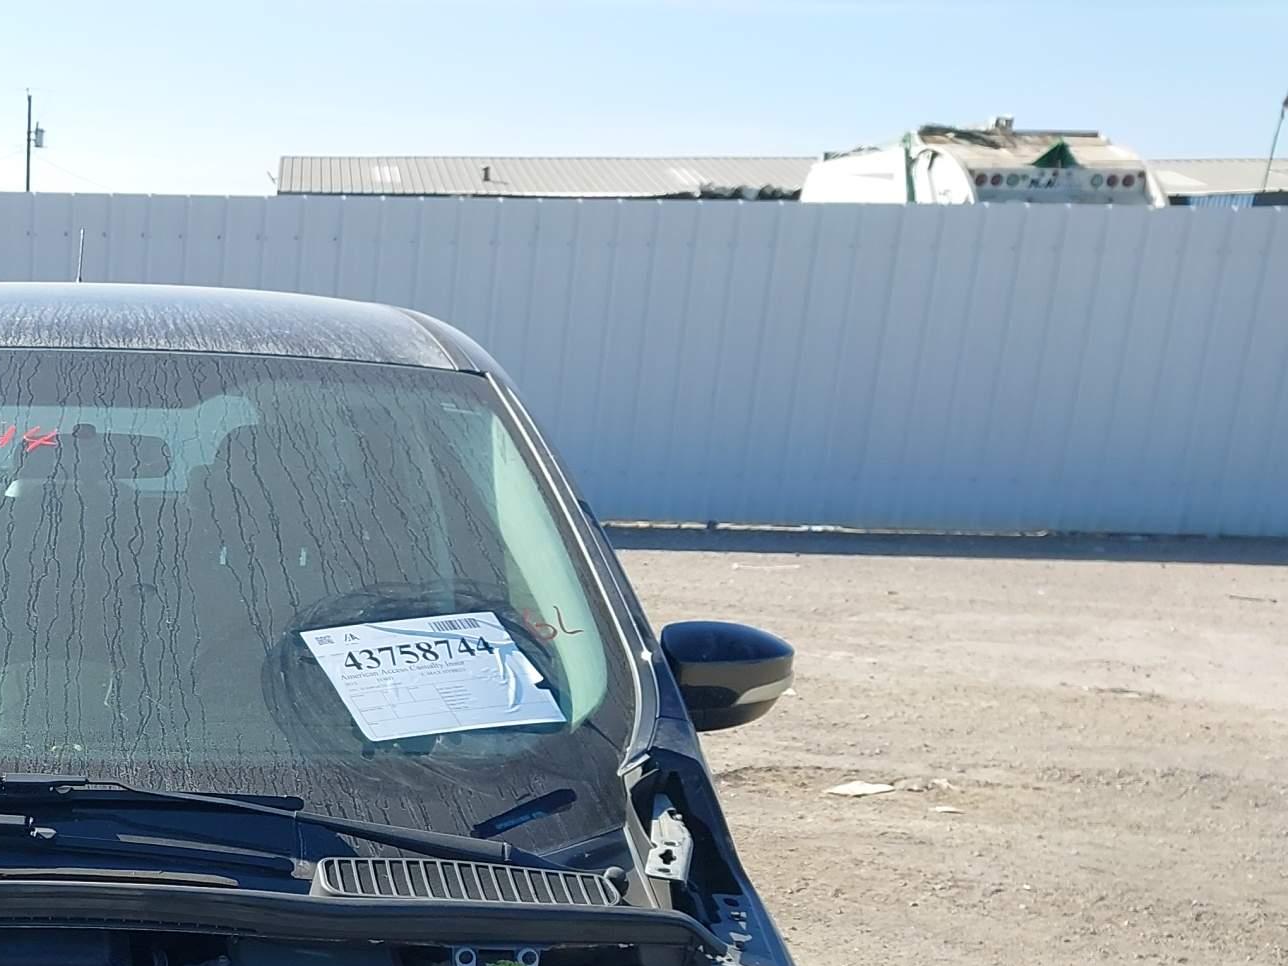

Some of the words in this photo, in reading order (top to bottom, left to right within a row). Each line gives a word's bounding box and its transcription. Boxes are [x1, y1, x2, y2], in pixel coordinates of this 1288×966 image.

[344, 636, 495, 670] 43758744
[341, 669, 378, 681] American
[381, 665, 408, 676] Access
[409, 661, 443, 672] Casualty
